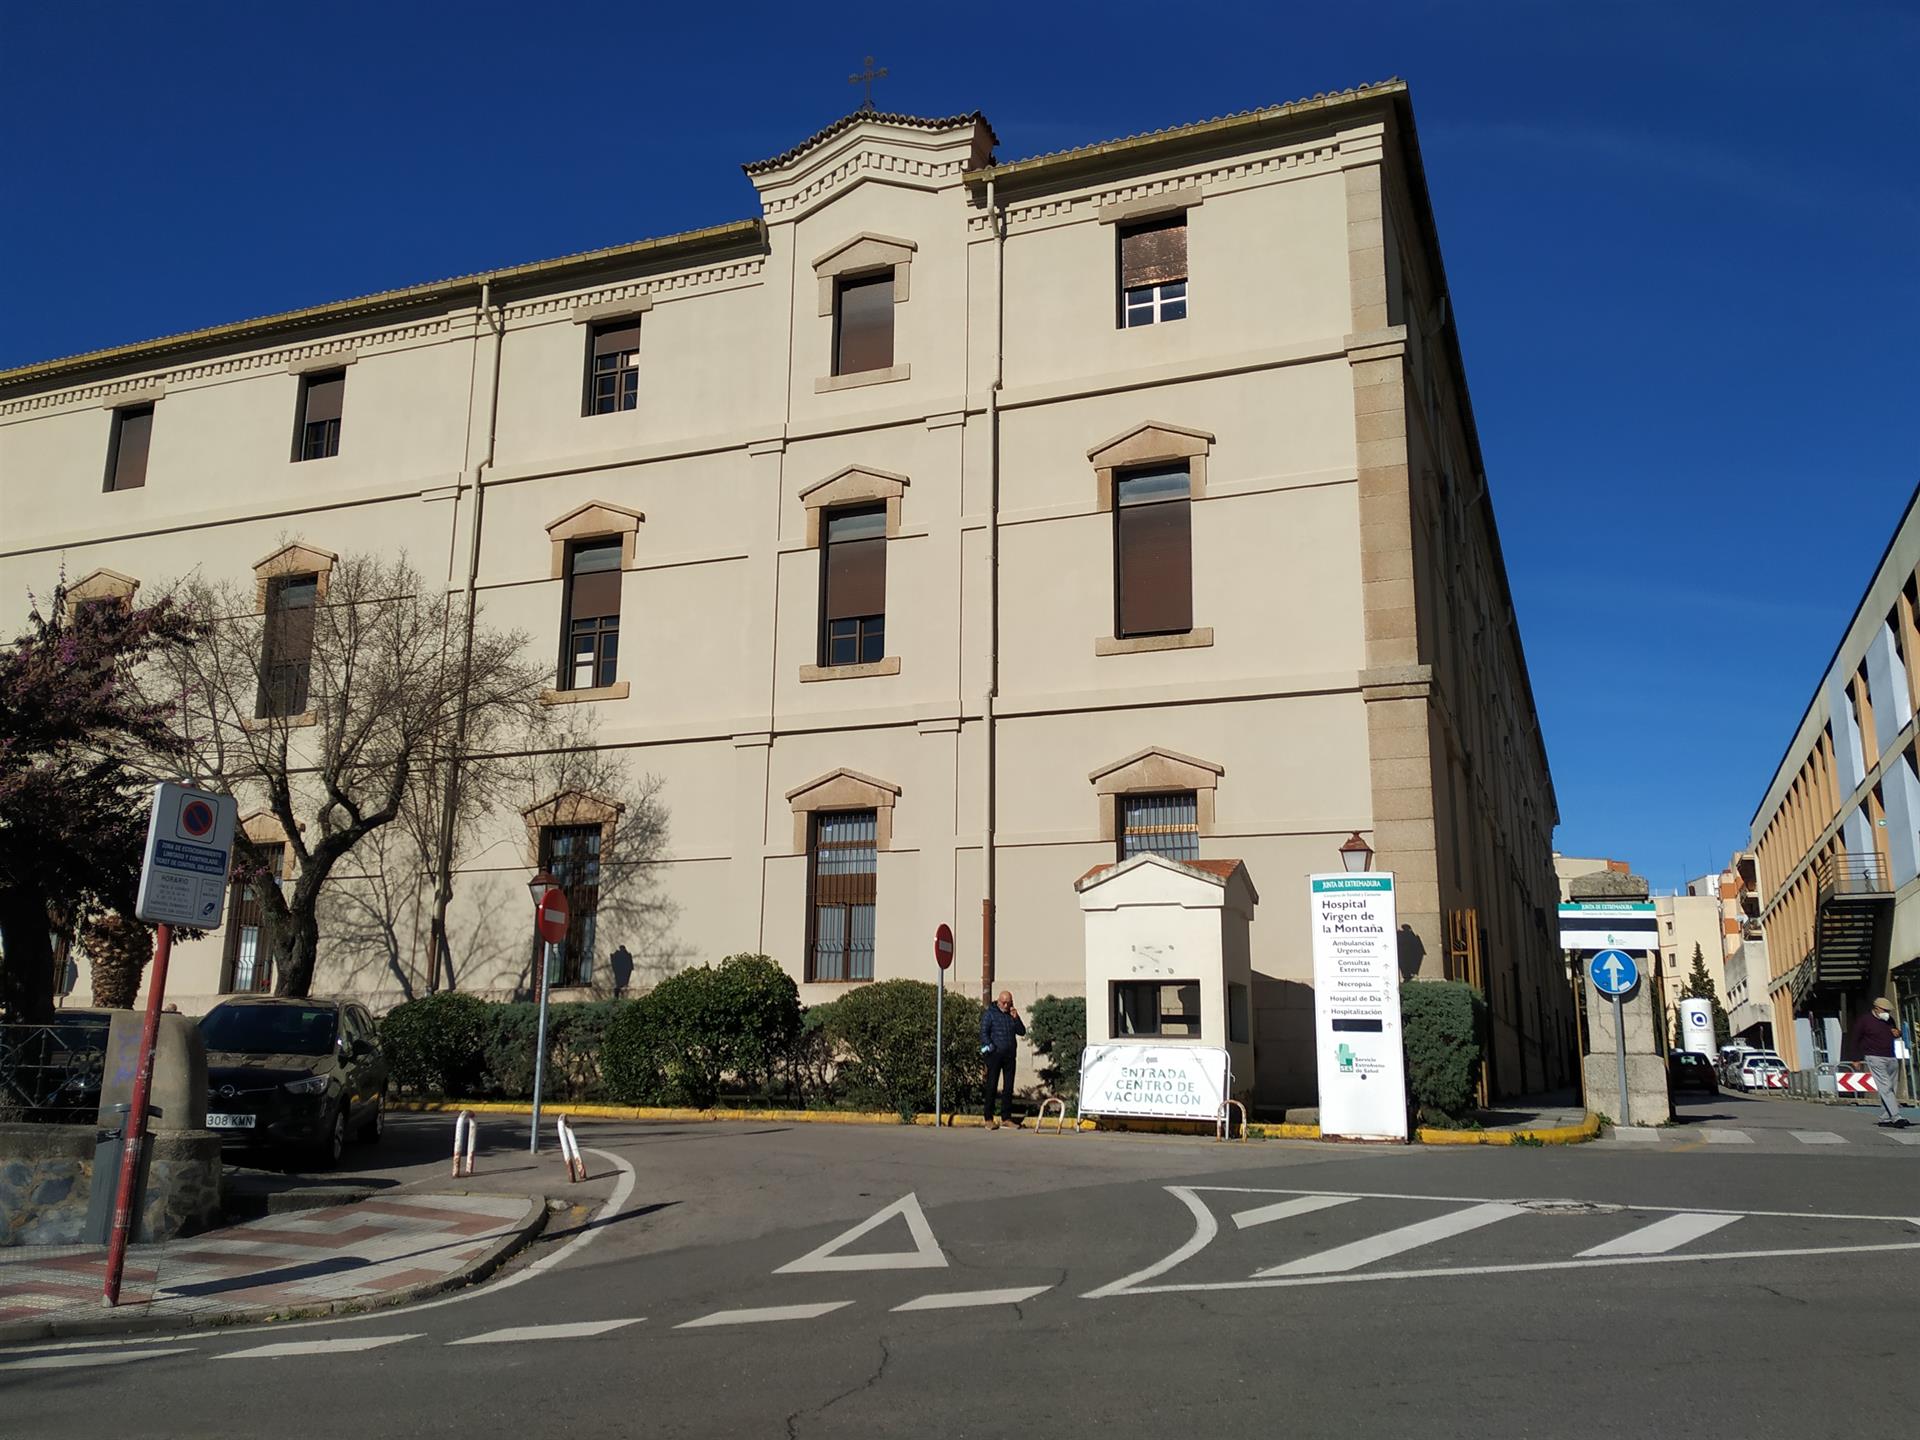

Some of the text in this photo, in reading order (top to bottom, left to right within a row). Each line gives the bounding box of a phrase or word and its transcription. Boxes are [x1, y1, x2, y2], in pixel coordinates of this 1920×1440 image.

[1322, 880, 1382, 889] JUNTA DE EXTREMADURA
[1322, 900, 1367, 911] Hospital
[1322, 911, 1375, 924] Virgen de
[1322, 923, 1384, 934] la Montaña
[1337, 947, 1371, 955] Urgencias
[1337, 981, 1373, 989] Necropsia
[1330, 995, 1358, 1003] Hospital
[1330, 1008, 1383, 1016] Hospitalización
[1121, 1067, 1187, 1080] ENTRADA
[1116, 1079, 1195, 1092] CENTRO DE
[1105, 1091, 1201, 1105] VACUNACIÓN
[231, 1116, 253, 1126] KMN
